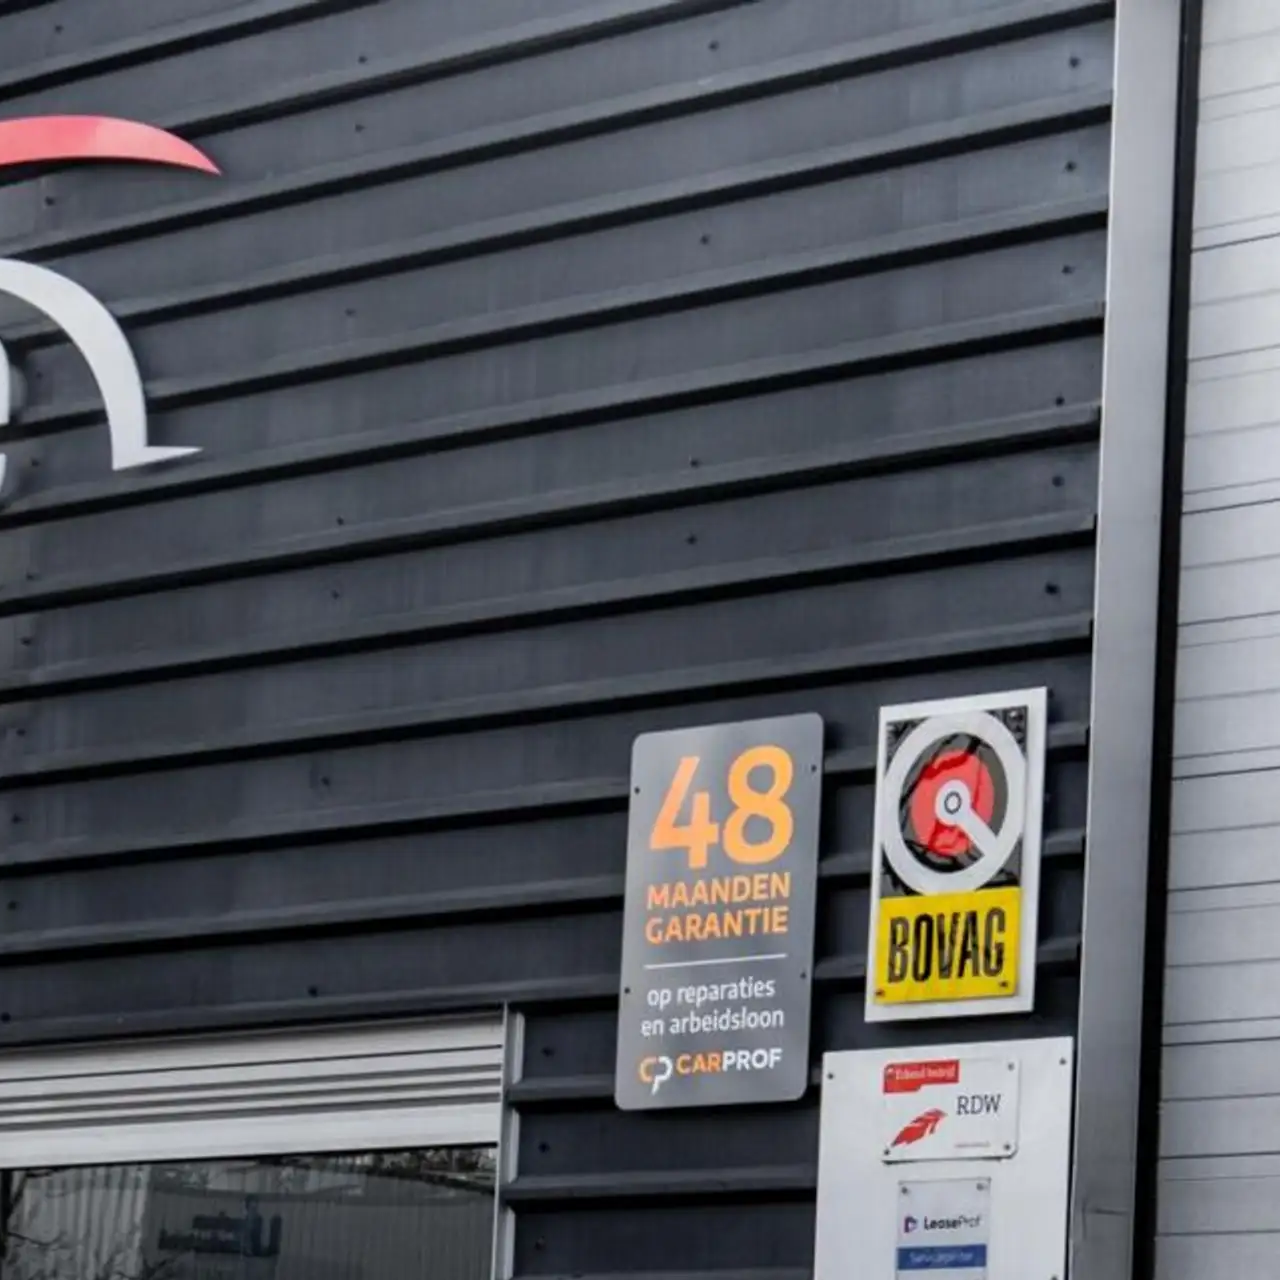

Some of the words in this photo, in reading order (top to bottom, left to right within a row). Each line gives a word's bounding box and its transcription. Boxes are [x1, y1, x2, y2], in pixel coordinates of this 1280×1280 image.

[650, 744, 794, 869] 48
[647, 872, 791, 910] MAANDEN
[645, 905, 789, 944] GARANTIE
[888, 907, 1006, 984] BOVAG
[647, 987, 672, 1010] op
[677, 976, 776, 1007] reparaties
[640, 1018, 665, 1036] en
[669, 1007, 785, 1034] arbeidsloon
[676, 1048, 783, 1074] CARPROF
[956, 1094, 1001, 1115] RDW
